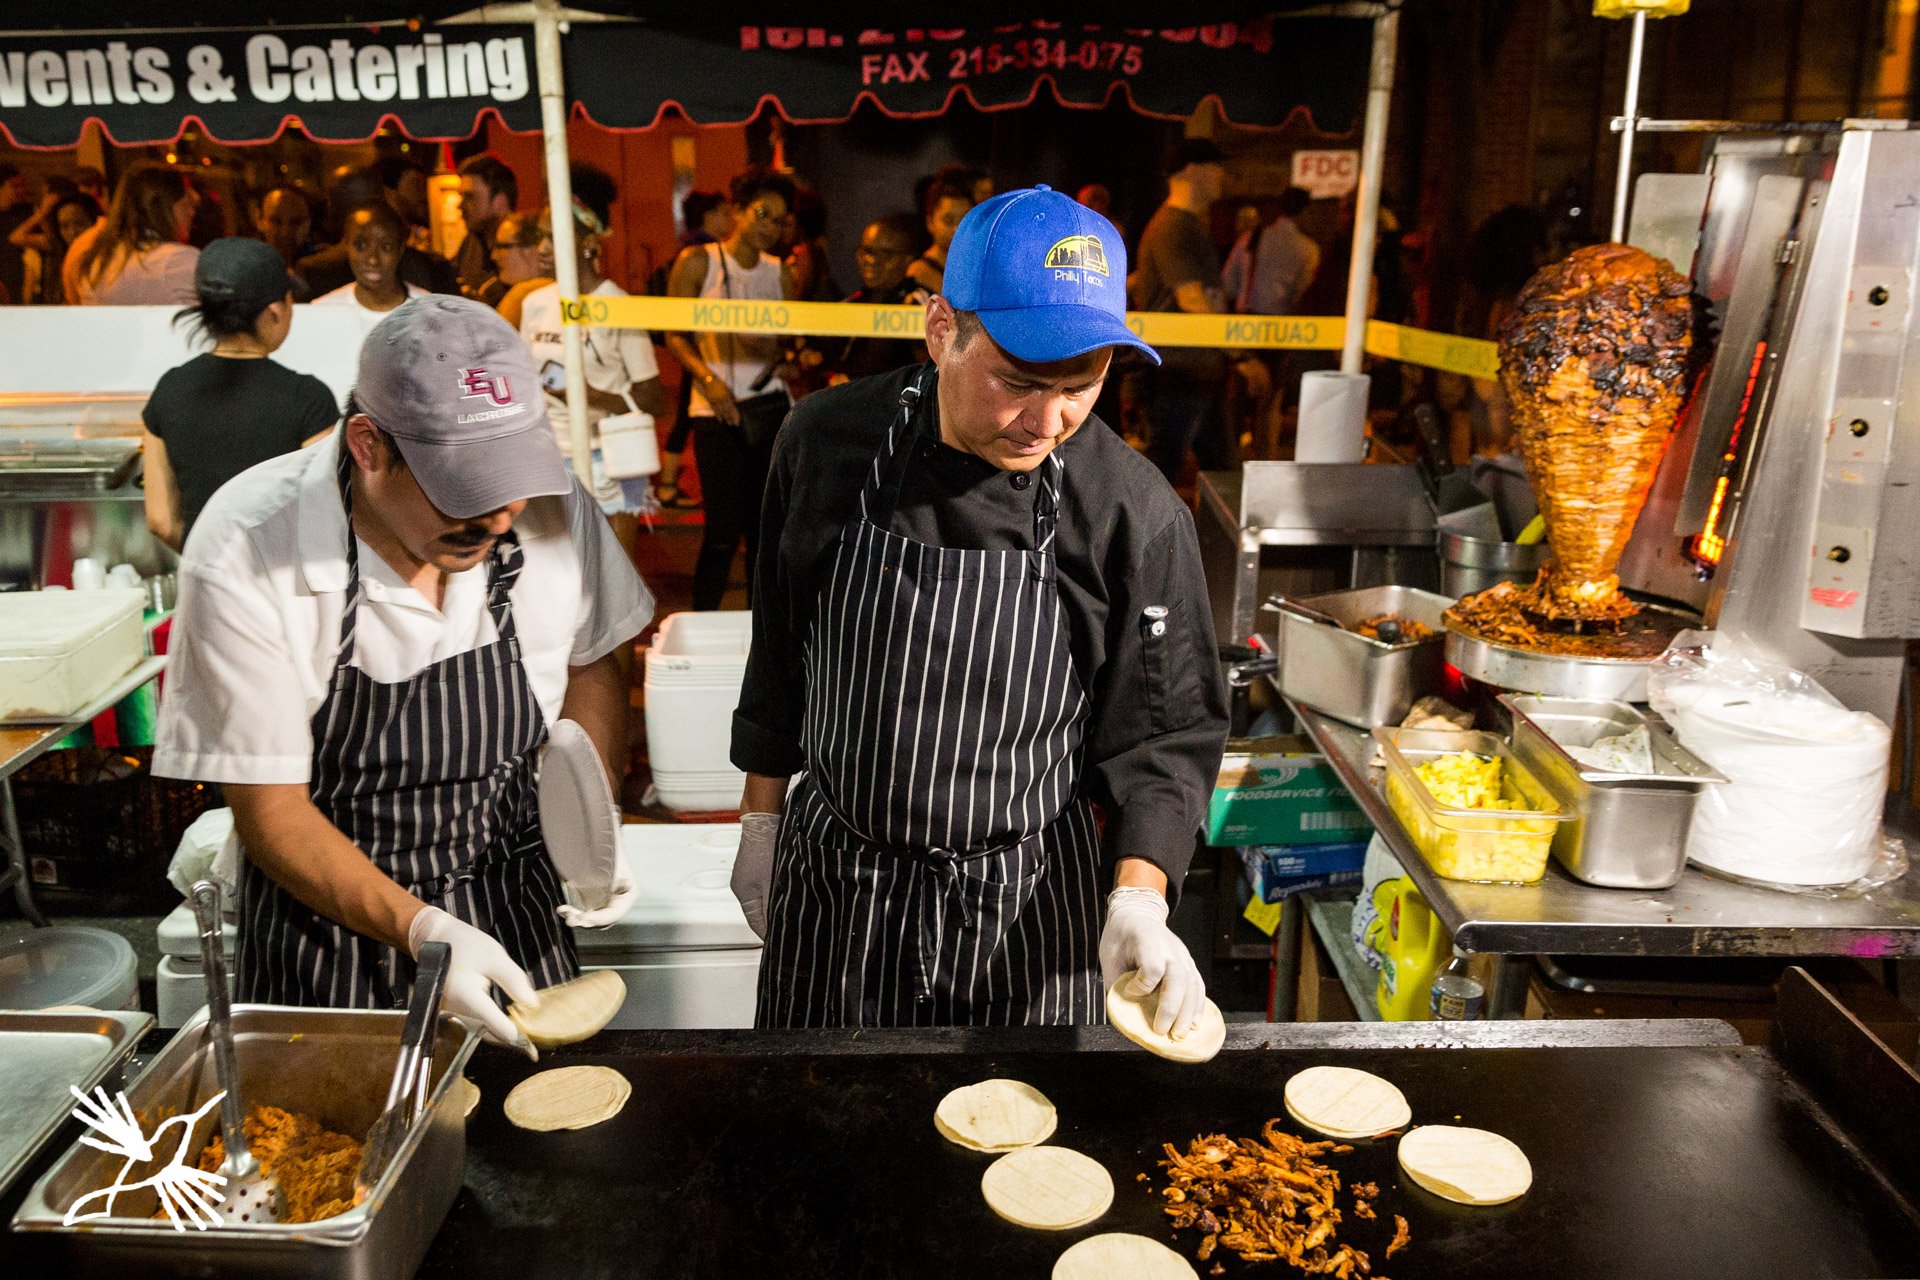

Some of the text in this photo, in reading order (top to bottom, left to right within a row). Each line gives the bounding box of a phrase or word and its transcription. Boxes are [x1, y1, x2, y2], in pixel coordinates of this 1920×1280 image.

[186, 45, 237, 104] &
[245, 33, 529, 102] Catering
[860, 51, 931, 86] FAX
[1300, 155, 1351, 178] FDC
[1054, 269, 1104, 288] Philly Tacos
